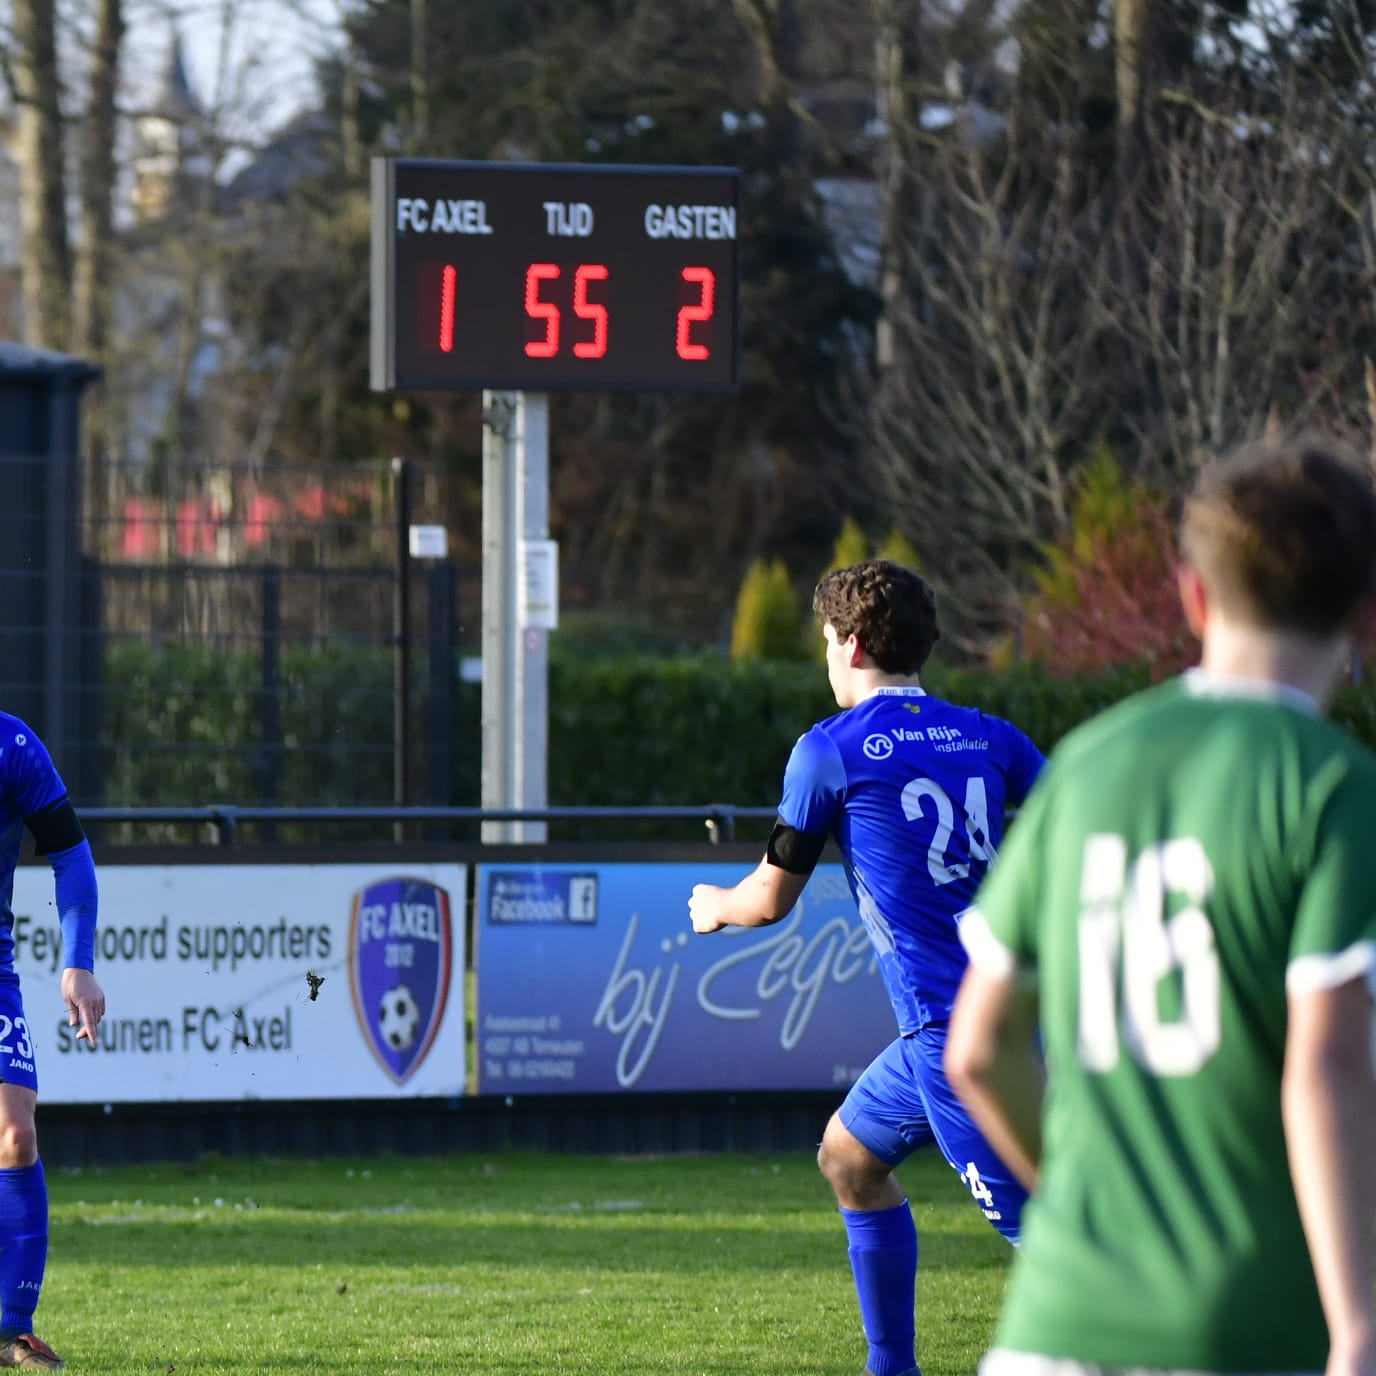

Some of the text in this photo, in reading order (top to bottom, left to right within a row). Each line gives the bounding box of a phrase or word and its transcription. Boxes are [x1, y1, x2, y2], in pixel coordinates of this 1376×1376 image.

[397, 199, 493, 234] FC AXEL
[543, 202, 594, 236] TIJD
[644, 204, 736, 239] GASTEN
[439, 264, 456, 352] 1
[524, 263, 609, 358] 55
[675, 266, 716, 360] 2
[891, 725, 962, 744] Van Rijn
[933, 738, 989, 753] installatie
[900, 777, 1000, 888] 24
[359, 902, 440, 943] FC AXEL
[490, 894, 566, 921] Facebook
[177, 917, 332, 973] supporters
[1076, 832, 1222, 1078] 16
[592, 912, 681, 1088] bij
[183, 1007, 221, 1052] FC
[232, 1004, 292, 1052] Axel
[9, 1058, 35, 1073] JAKO
